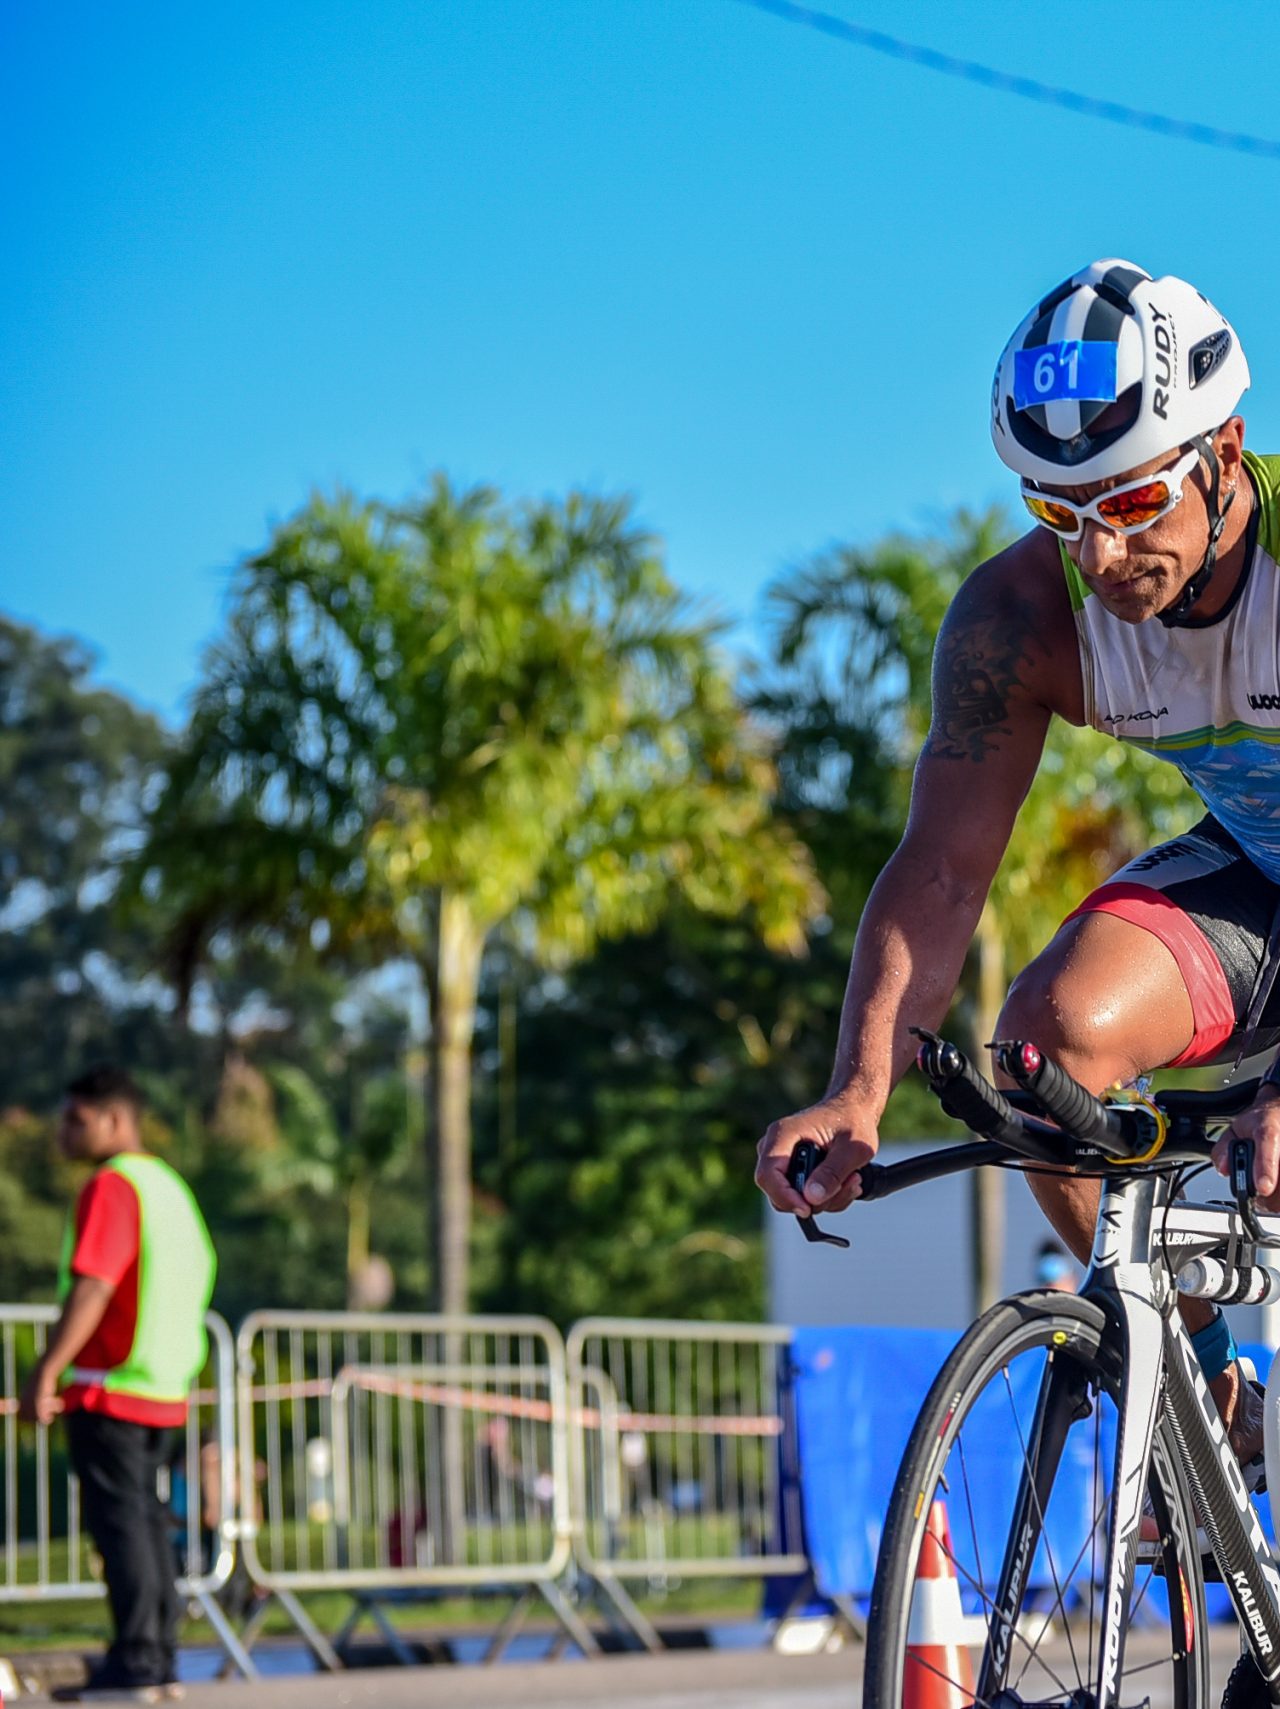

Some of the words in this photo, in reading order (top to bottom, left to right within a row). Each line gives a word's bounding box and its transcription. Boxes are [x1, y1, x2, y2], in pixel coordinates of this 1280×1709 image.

[1033, 348, 1079, 393] 61
[1148, 302, 1171, 421] RUDY
[1152, 1232, 1195, 1247] KLIBUR
[1231, 1570, 1274, 1656] KALIBUR
